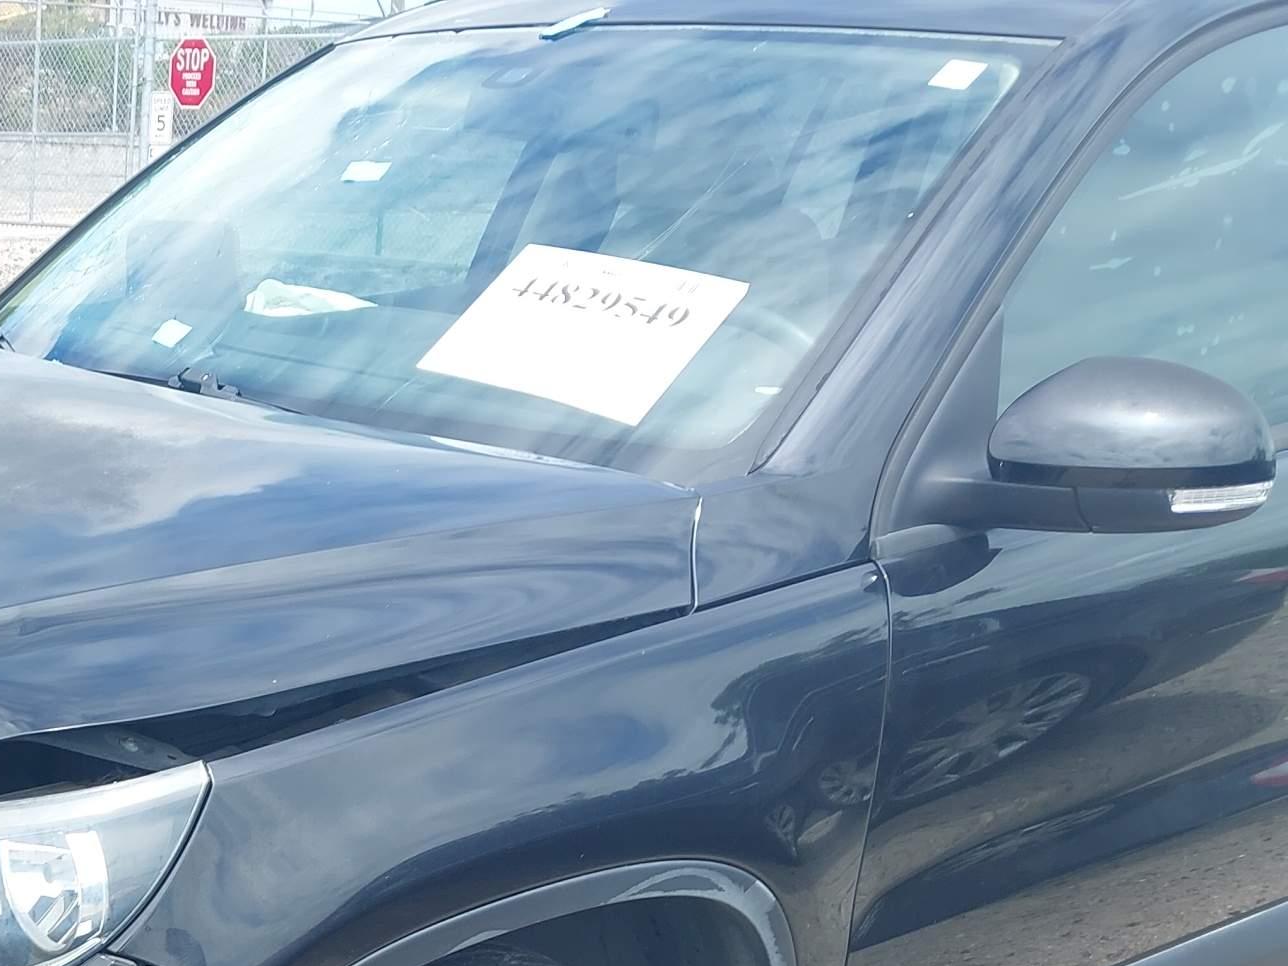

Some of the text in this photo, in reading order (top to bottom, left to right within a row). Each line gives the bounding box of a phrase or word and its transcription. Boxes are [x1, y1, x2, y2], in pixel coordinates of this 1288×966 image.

[190, 13, 246, 31] WELDING
[176, 48, 210, 71] STOP
[156, 114, 166, 132] 5
[512, 277, 690, 327] 44829549
